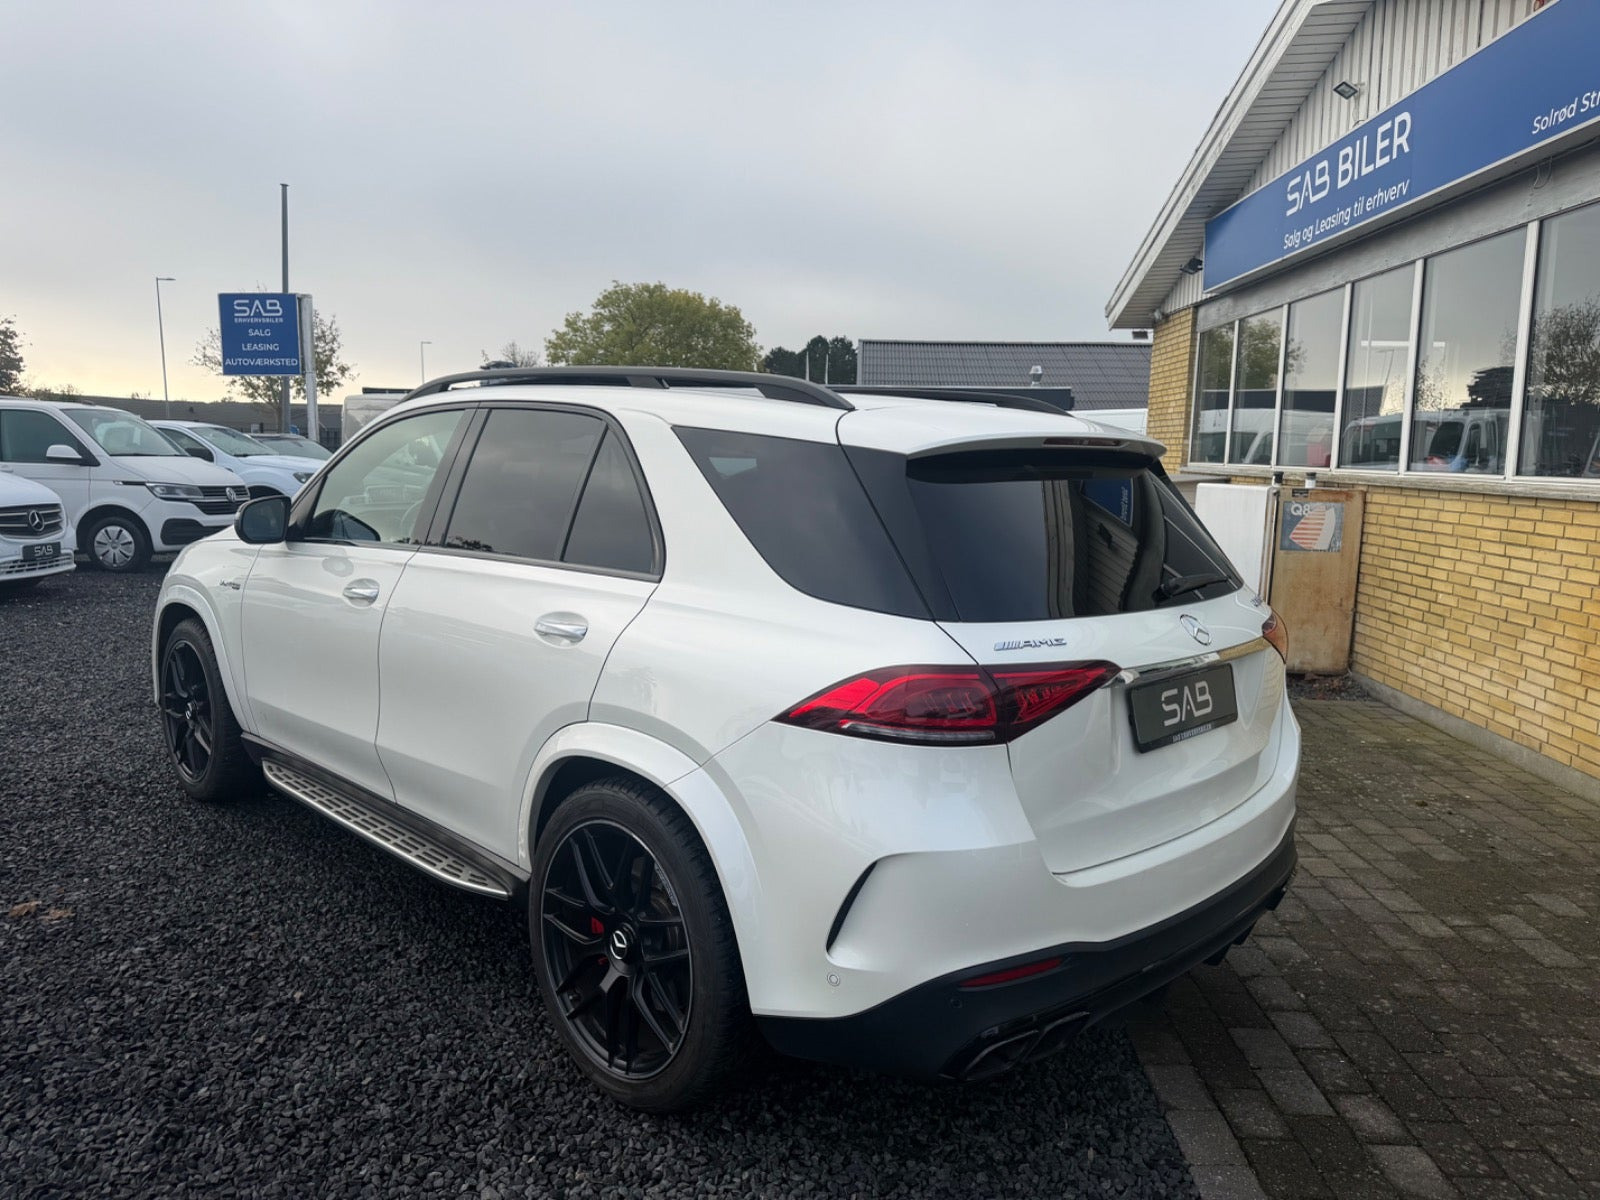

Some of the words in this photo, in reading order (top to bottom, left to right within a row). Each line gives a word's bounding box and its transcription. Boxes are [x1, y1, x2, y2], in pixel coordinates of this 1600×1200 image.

[1531, 97, 1578, 134] Solrød
[1286, 159, 1330, 217] SAB
[1337, 111, 1412, 190] BILER
[1283, 230, 1301, 249] Salg
[1302, 225, 1313, 242] og
[1314, 207, 1351, 235] Leasing
[1353, 196, 1365, 217] til
[1366, 179, 1410, 211] erhverv
[233, 299, 283, 317] SAB
[248, 328, 271, 336] SALG
[241, 343, 280, 351] LEASING
[225, 358, 298, 366] AUTOVÆRKSTED
[1291, 502, 1310, 516] Q8
[34, 545, 53, 557] SAB
[1161, 681, 1213, 727] SAB
